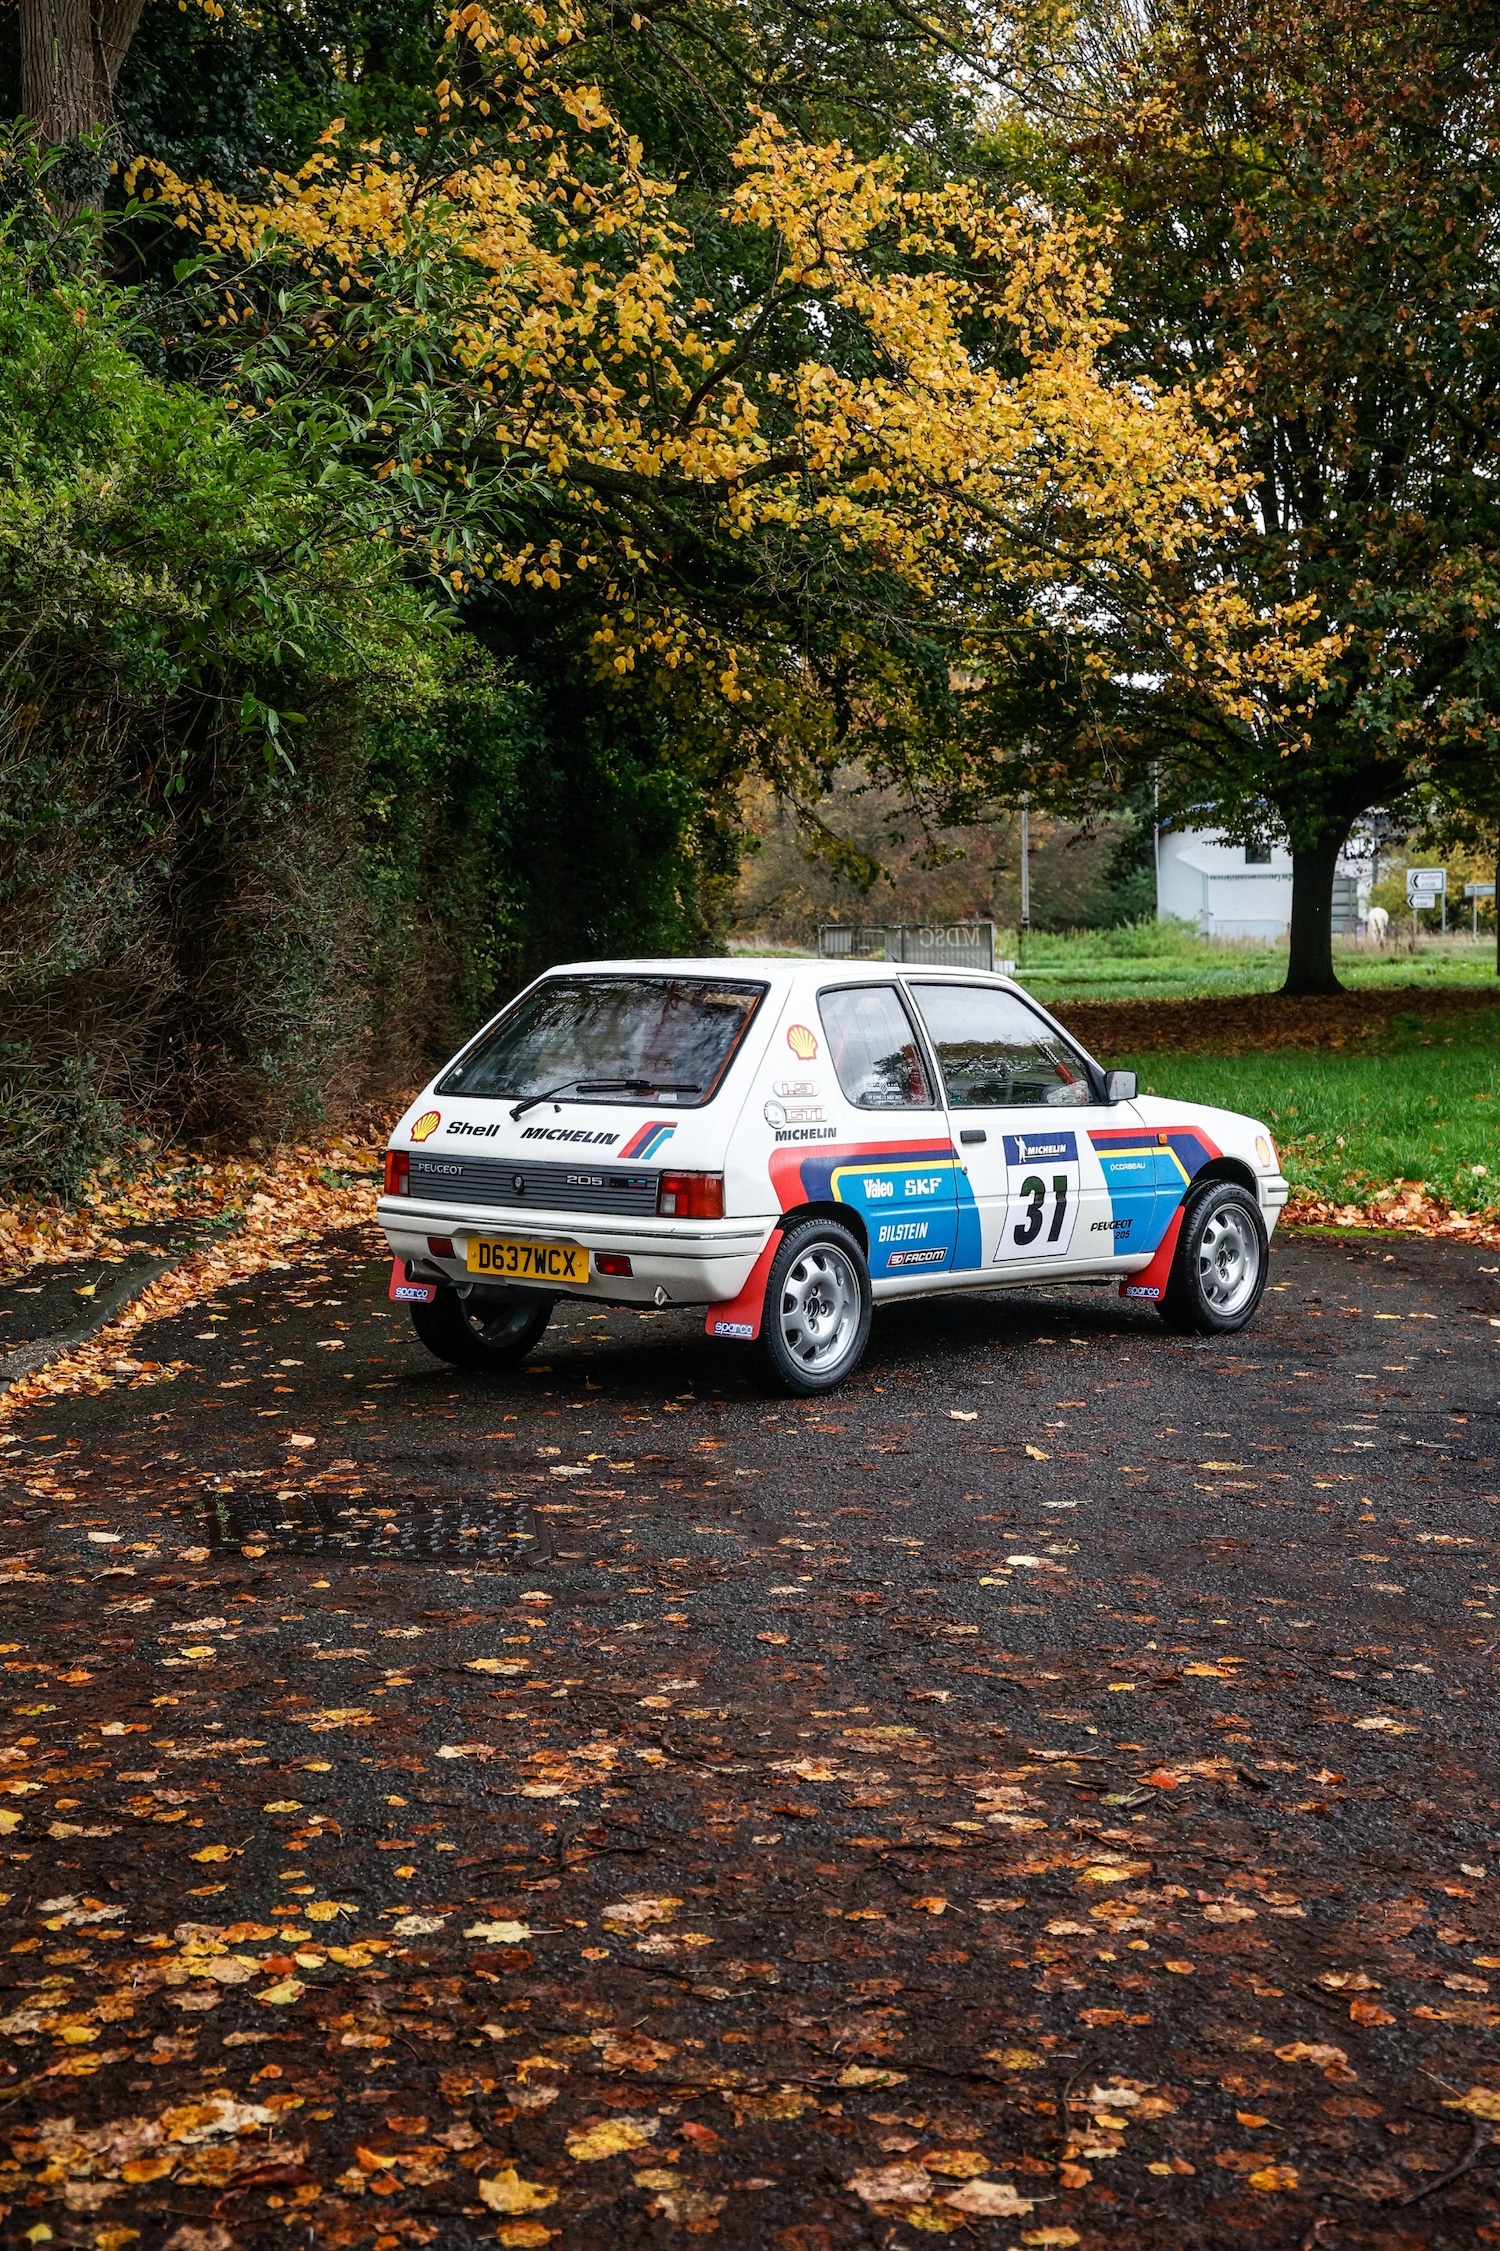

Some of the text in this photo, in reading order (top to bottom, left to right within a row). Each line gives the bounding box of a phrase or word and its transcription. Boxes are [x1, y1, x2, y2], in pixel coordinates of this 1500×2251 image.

[782, 1083, 813, 1095] 1.9
[785, 1107, 822, 1120] GTI
[446, 1121, 500, 1137] Shell
[775, 1127, 837, 1141] MICHELIN
[520, 1127, 620, 1145] MICHELIN
[1027, 1144, 1067, 1155] MICHELIN
[418, 1162, 464, 1176] PEUGEOT
[1115, 1162, 1146, 1171] CORBEAU
[566, 1175, 603, 1186] 205
[904, 1178, 942, 1196] SKF
[863, 1178, 894, 1198] Valeo
[1013, 1175, 1067, 1246] 31
[1090, 1218, 1133, 1232] PEUGEOT
[878, 1222, 928, 1242] BILSTEIN
[1114, 1230, 1130, 1240] 205
[478, 1243, 576, 1277] D637WCX
[905, 1250, 944, 1263] FACOM
[395, 1287, 429, 1298] sparco
[1126, 1286, 1160, 1297] sparco
[714, 1322, 753, 1335] sparco
